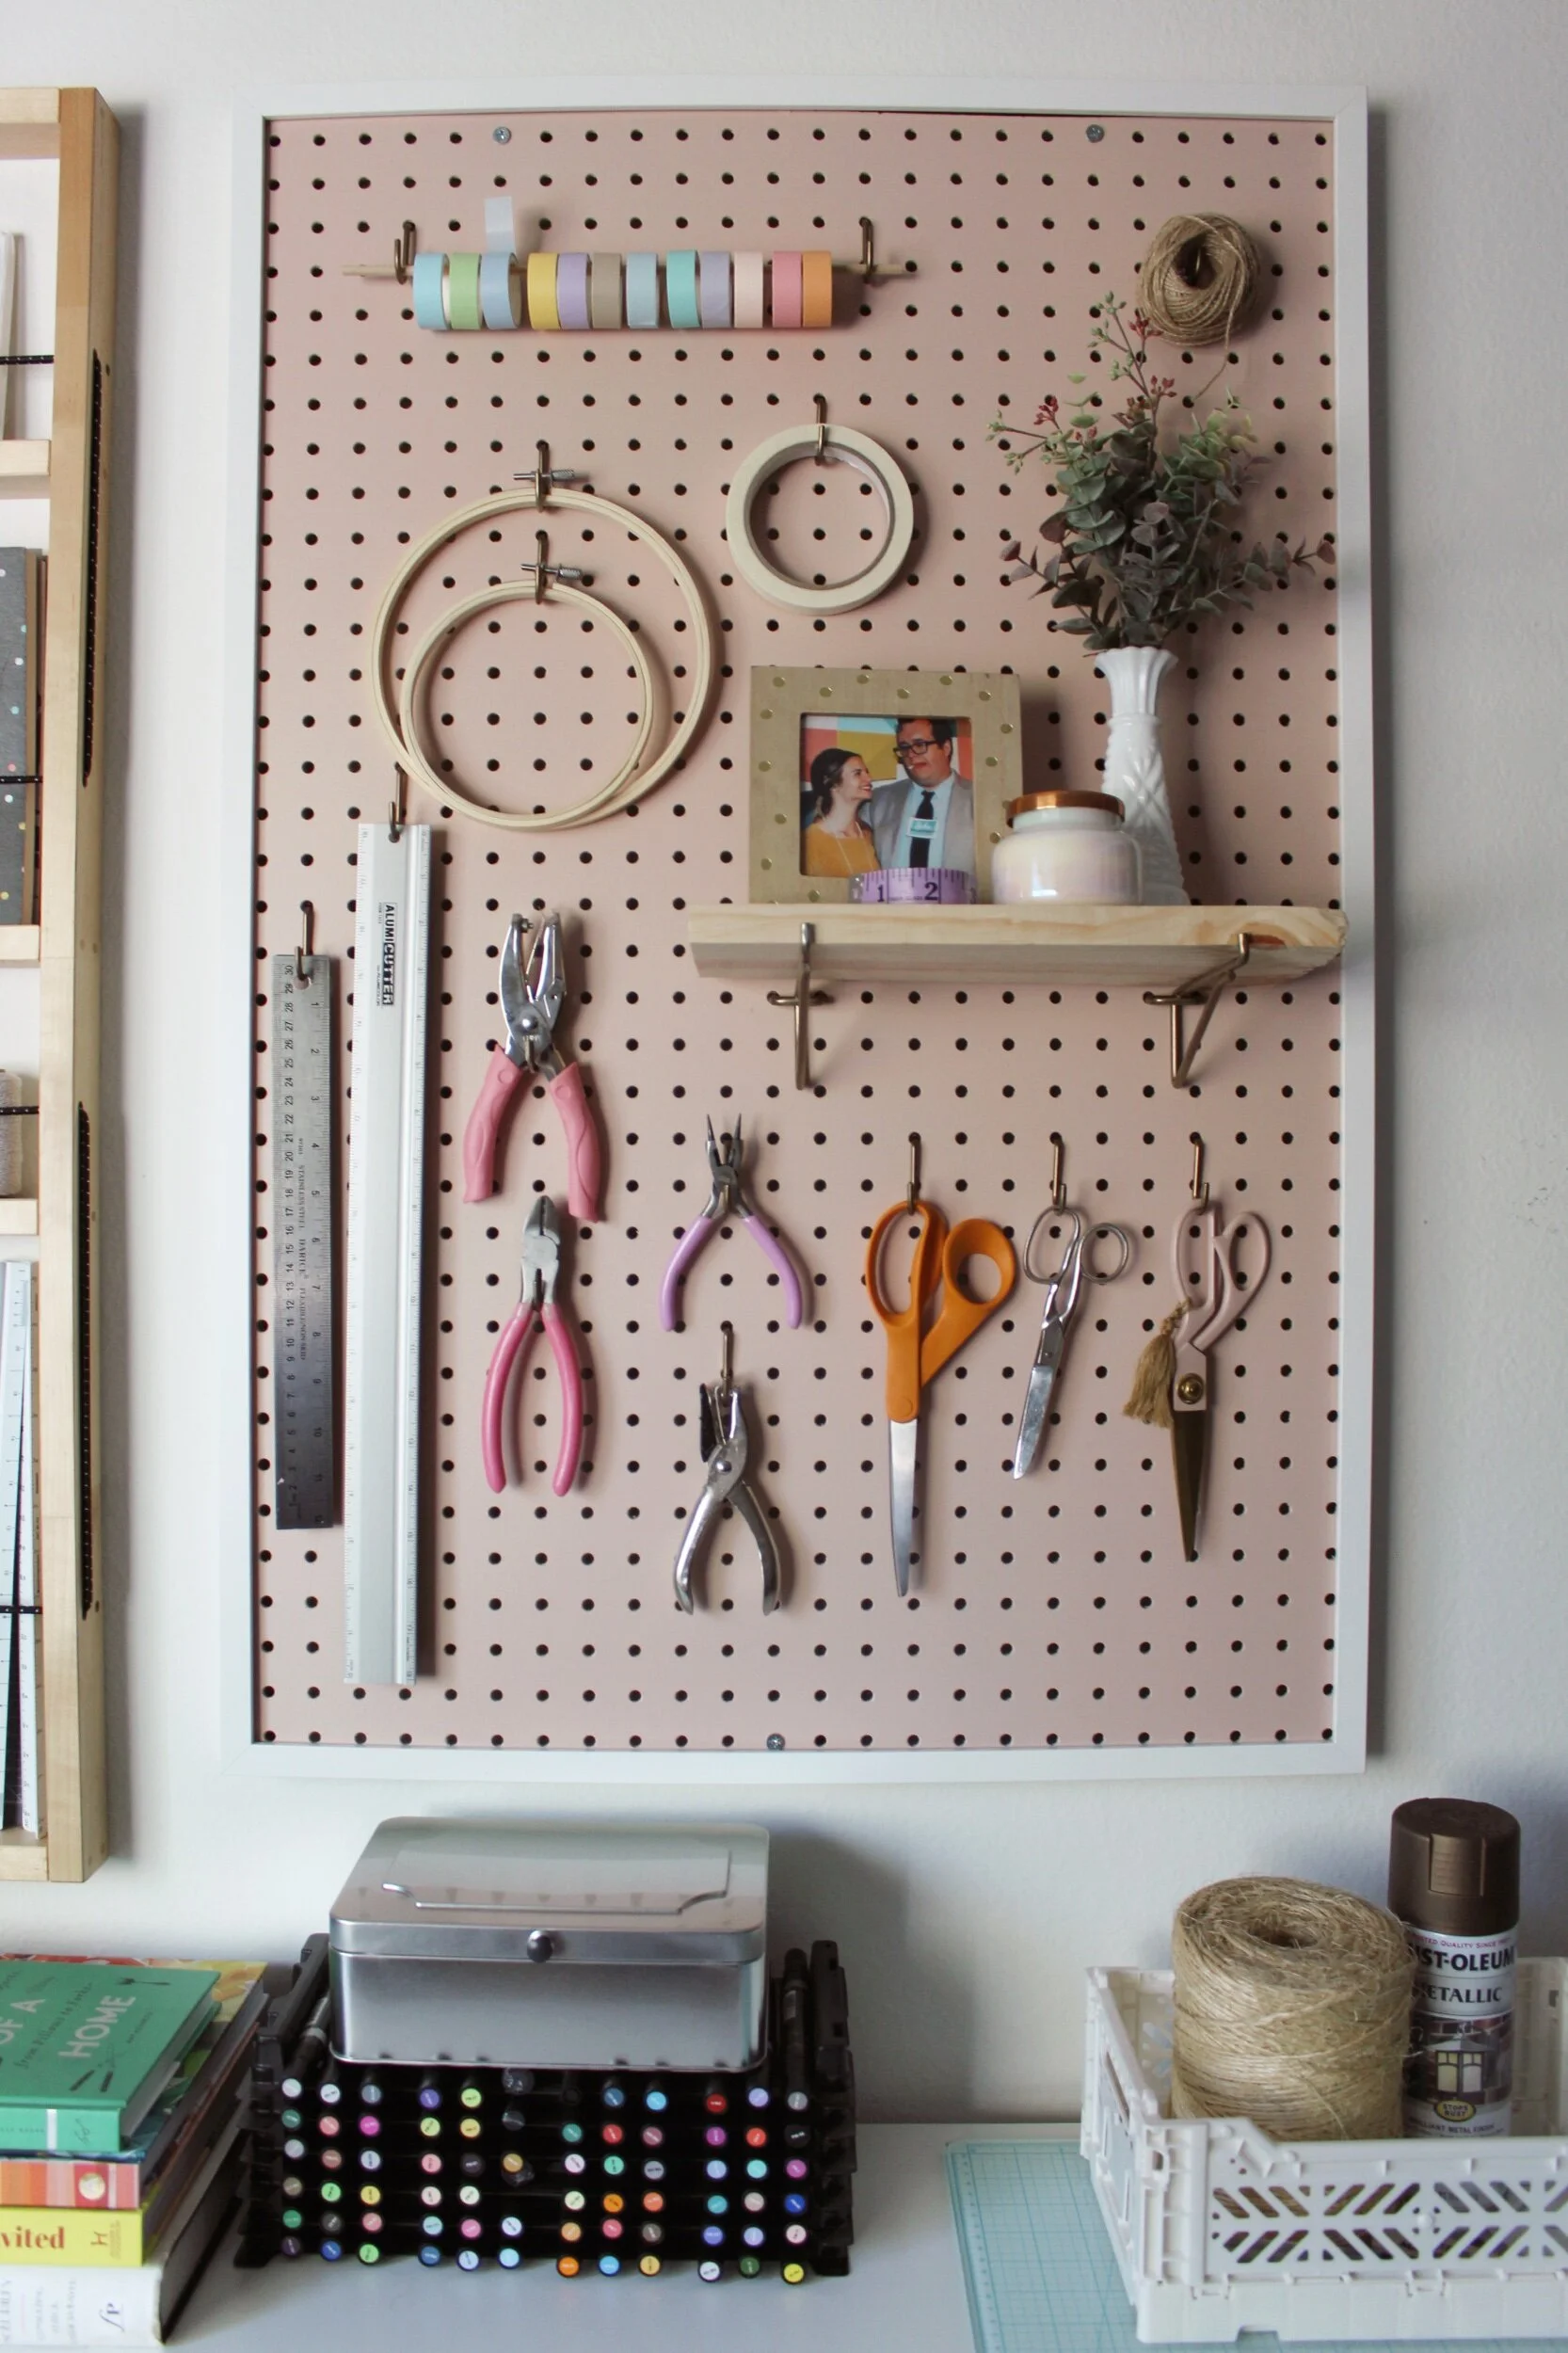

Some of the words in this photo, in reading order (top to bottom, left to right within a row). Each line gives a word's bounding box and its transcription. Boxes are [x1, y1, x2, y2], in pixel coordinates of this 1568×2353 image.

[877, 885, 885, 903] 1
[924, 882, 938, 901] 2
[383, 904, 395, 1004] ALUMICUTTER
[285, 966, 294, 975] 30
[285, 984, 294, 994] 29
[285, 1002, 294, 1013] 28
[285, 1021, 294, 1032] 27
[285, 1039, 294, 1050] 26
[285, 1058, 294, 1068] 25
[285, 1077, 294, 1087] 24
[285, 1096, 294, 1106] 23
[285, 1114, 294, 1124] 22
[285, 1133, 294, 1143] 21
[285, 1151, 294, 1161] 20
[285, 1170, 294, 1179] 19
[285, 1188, 294, 1198] 18
[285, 1208, 294, 1216] 17
[285, 1225, 294, 1235] 16
[286, 1244, 294, 1254] 15
[286, 1263, 294, 1273] 14
[286, 1282, 294, 1291] 13
[286, 1300, 295, 1310] 12
[286, 1319, 294, 1327] 11
[286, 1337, 295, 1348] 10
[314, 1427, 322, 1437] 10
[1441, 1940, 1473, 1948] QUALITY
[1413, 1944, 1514, 1971] ST-OLEUM
[10, 1999, 46, 2014] A
[57, 1995, 137, 2058] HOME
